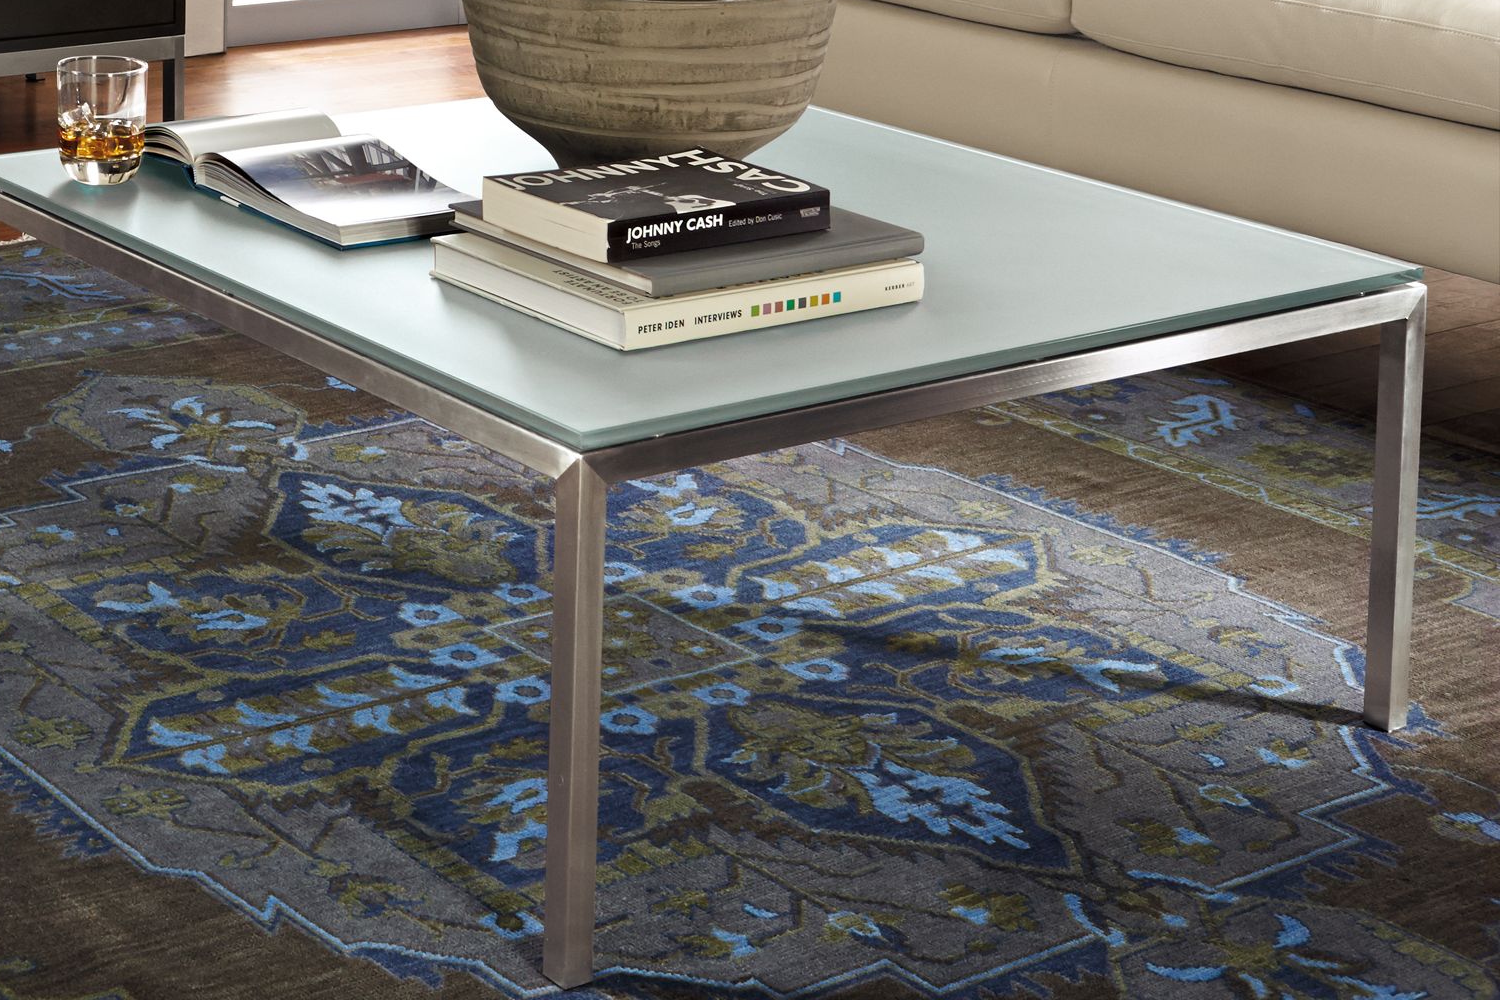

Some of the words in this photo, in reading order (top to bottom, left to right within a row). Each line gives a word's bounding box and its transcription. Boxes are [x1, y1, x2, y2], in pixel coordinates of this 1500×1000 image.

[494, 155, 679, 191] JOHNNY
[669, 149, 811, 192] CASH
[626, 220, 683, 244] JOHNNY
[686, 214, 723, 231] CASH
[728, 218, 746, 228] Edited
[747, 217, 754, 226] by
[755, 215, 767, 223] Don
[767, 213, 783, 222] Cusic
[631, 241, 642, 250] The
[644, 238, 661, 249] Songs
[551, 269, 591, 284] ARTIST
[564, 279, 632, 305] FORTUNATE
[593, 283, 610, 291] AN
[611, 289, 627, 297] BE
[638, 322, 662, 334] PETER
[665, 319, 685, 330] IDEN
[694, 309, 743, 325] INTERVIEWS
